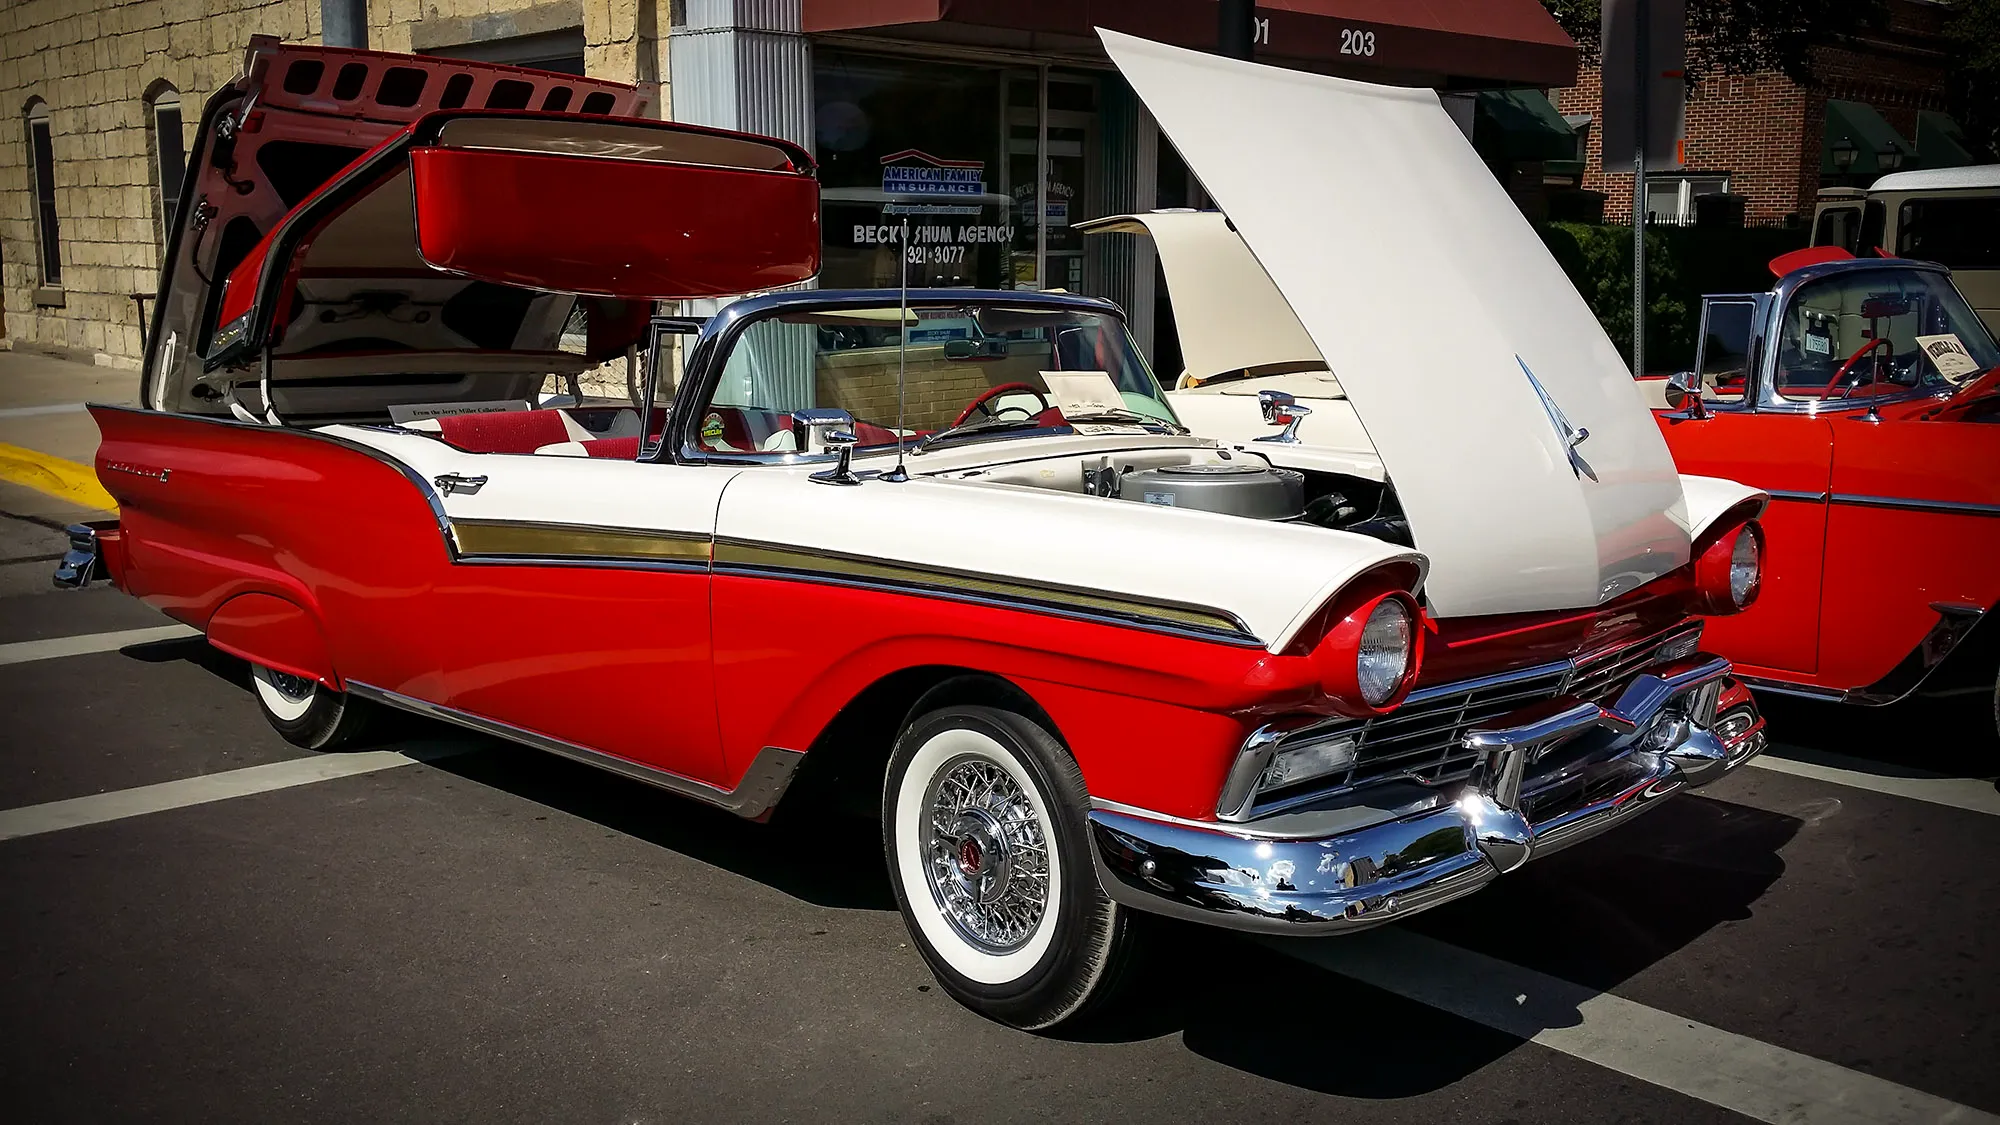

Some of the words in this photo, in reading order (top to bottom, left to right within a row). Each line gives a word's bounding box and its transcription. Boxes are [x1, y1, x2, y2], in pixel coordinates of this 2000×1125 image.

[1340, 28, 1375, 57] 203
[883, 166, 942, 180] AMERICAN
[944, 168, 983, 182] FAMILY
[891, 183, 975, 193] INSURANCE
[853, 225, 910, 244] BECKY
[913, 225, 952, 245] SHUM
[957, 225, 1015, 243] AGENCY
[1926, 340, 1955, 360] VEHICLE
